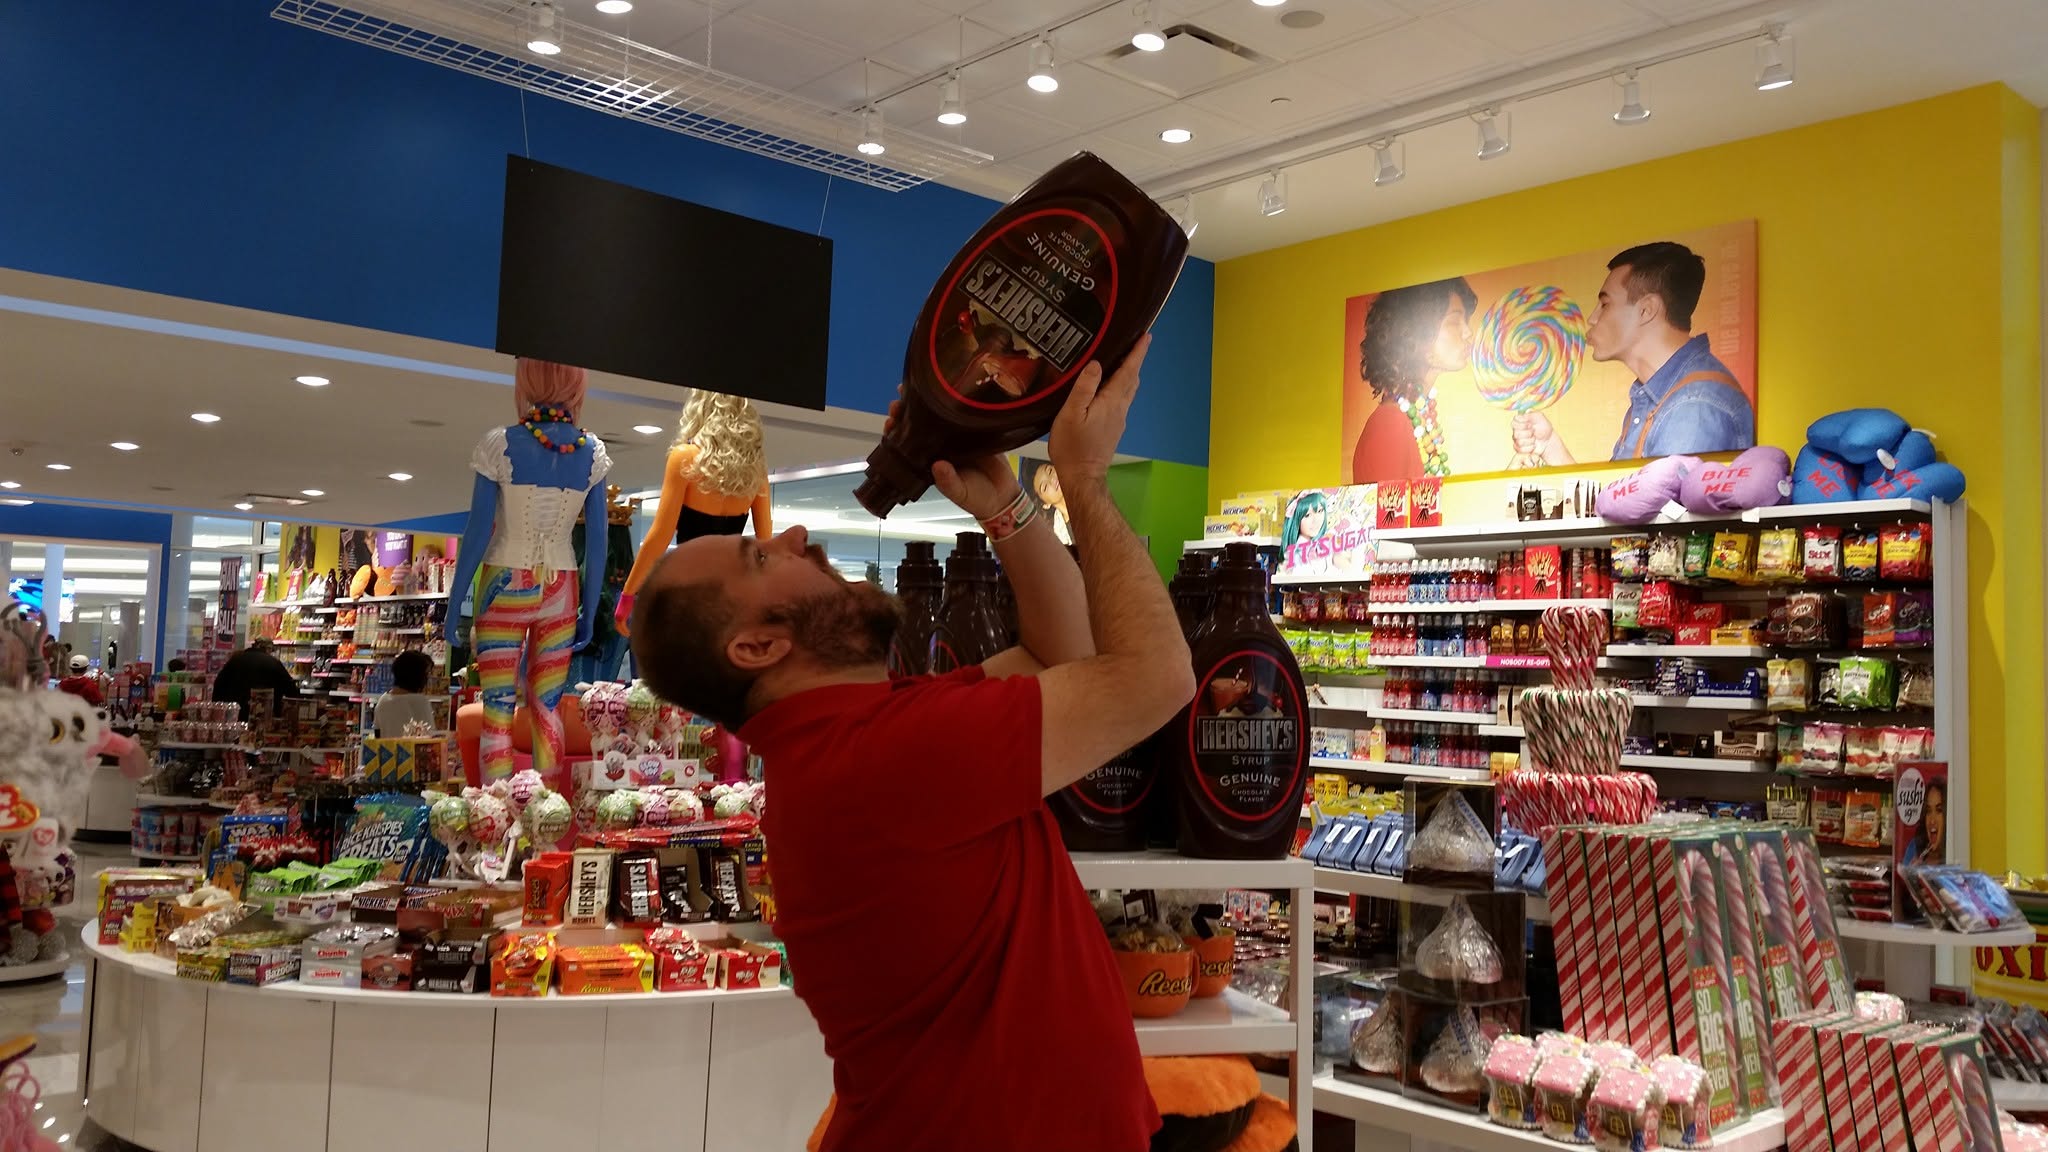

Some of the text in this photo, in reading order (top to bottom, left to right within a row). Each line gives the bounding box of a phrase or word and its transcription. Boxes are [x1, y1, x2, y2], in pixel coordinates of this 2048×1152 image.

[1048, 231, 1091, 269] CHOCOLATE
[1061, 230, 1090, 255] FLAVOR
[1027, 232, 1095, 292] GENUINE
[1021, 265, 1066, 302] SYRUP
[966, 260, 1085, 364] HERSHEY'S
[1701, 467, 1752, 482] BITE
[1704, 482, 1736, 495] ME
[1807, 469, 1841, 499] ME
[1613, 480, 1640, 501] ME
[219, 560, 241, 591] GIANT
[1527, 562, 1556, 578] POCKY
[217, 609, 236, 634] SALE
[1202, 719, 1293, 750] HERSHEY'S
[1085, 766, 1143, 781] GENUINE
[1232, 755, 1270, 766] SYRUP
[1219, 773, 1281, 788] GENUINE
[1231, 788, 1270, 796] CHOCOLATE
[1898, 777, 1924, 807] sushi
[340, 821, 404, 852] RICE KRISPIES
[577, 861, 597, 915] HERSHEY'S
[317, 949, 349, 960] Chunky
[1773, 965, 1787, 990] SO
[1696, 987, 1712, 1015] SO
[1778, 987, 1800, 1018] BIG
[1699, 1012, 1726, 1056] BIG
